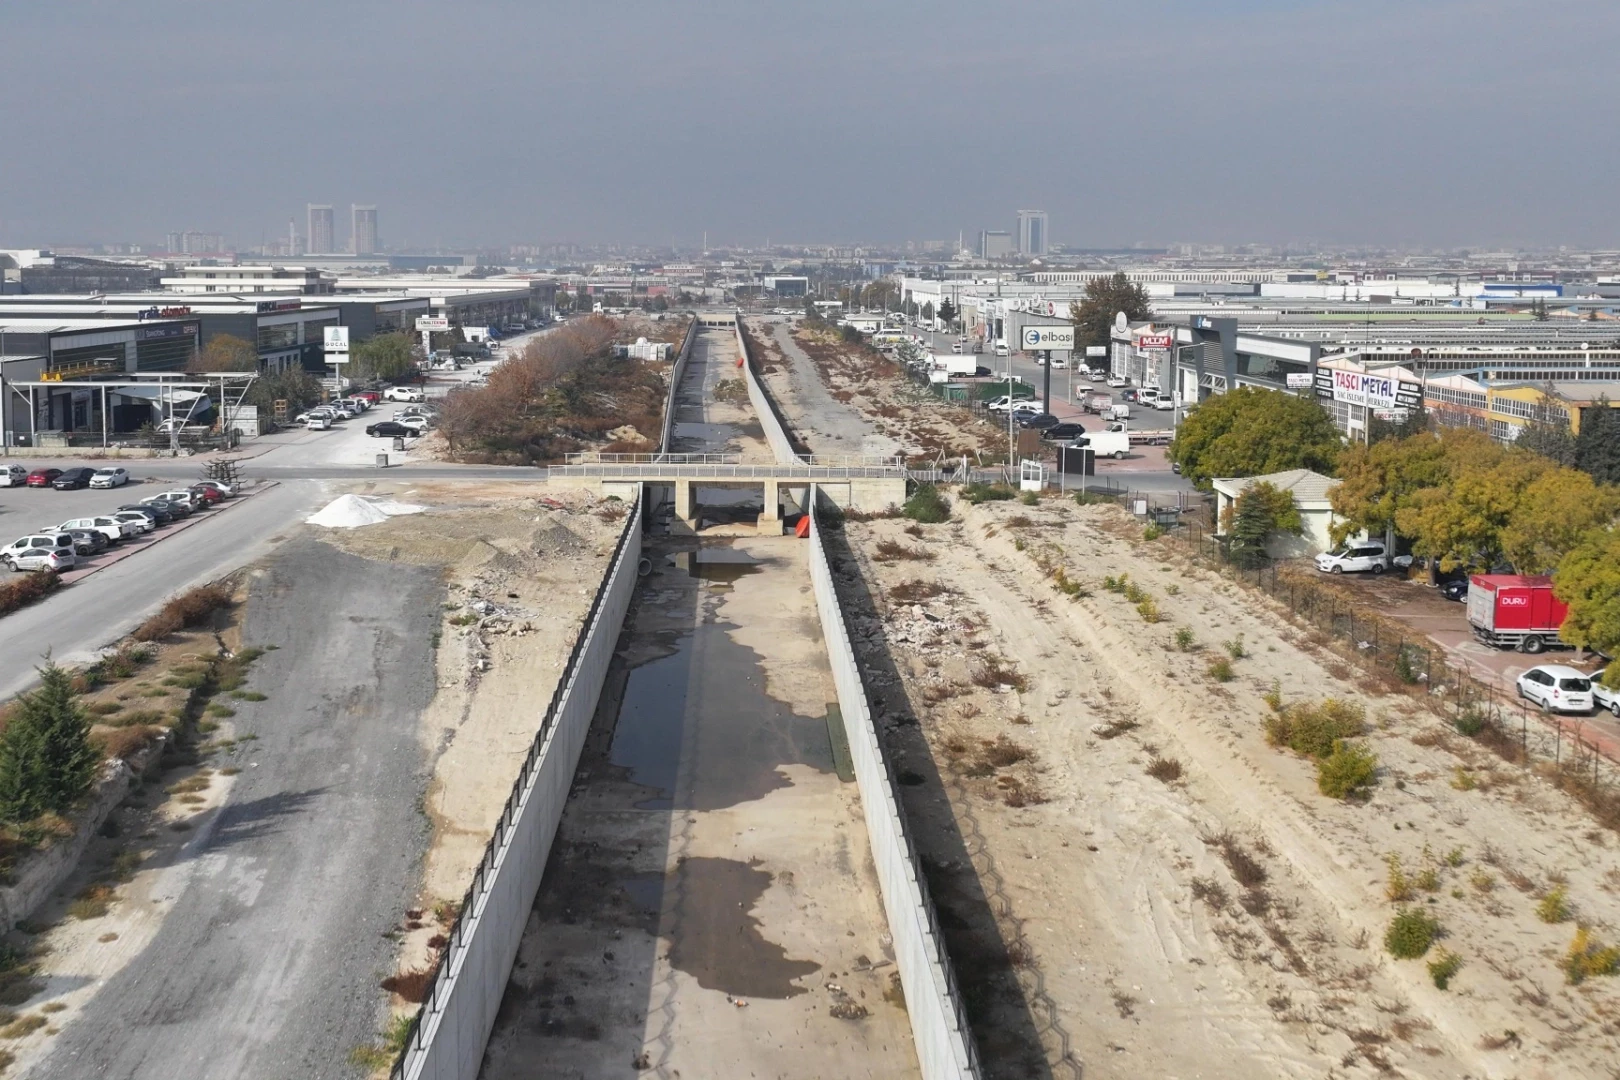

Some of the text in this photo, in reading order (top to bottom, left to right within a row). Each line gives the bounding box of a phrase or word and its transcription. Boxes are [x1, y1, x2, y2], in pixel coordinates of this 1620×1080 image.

[1335, 371, 1359, 391] TAŞCI
[1361, 376, 1394, 397] METAL
[1502, 597, 1527, 605] DURU
